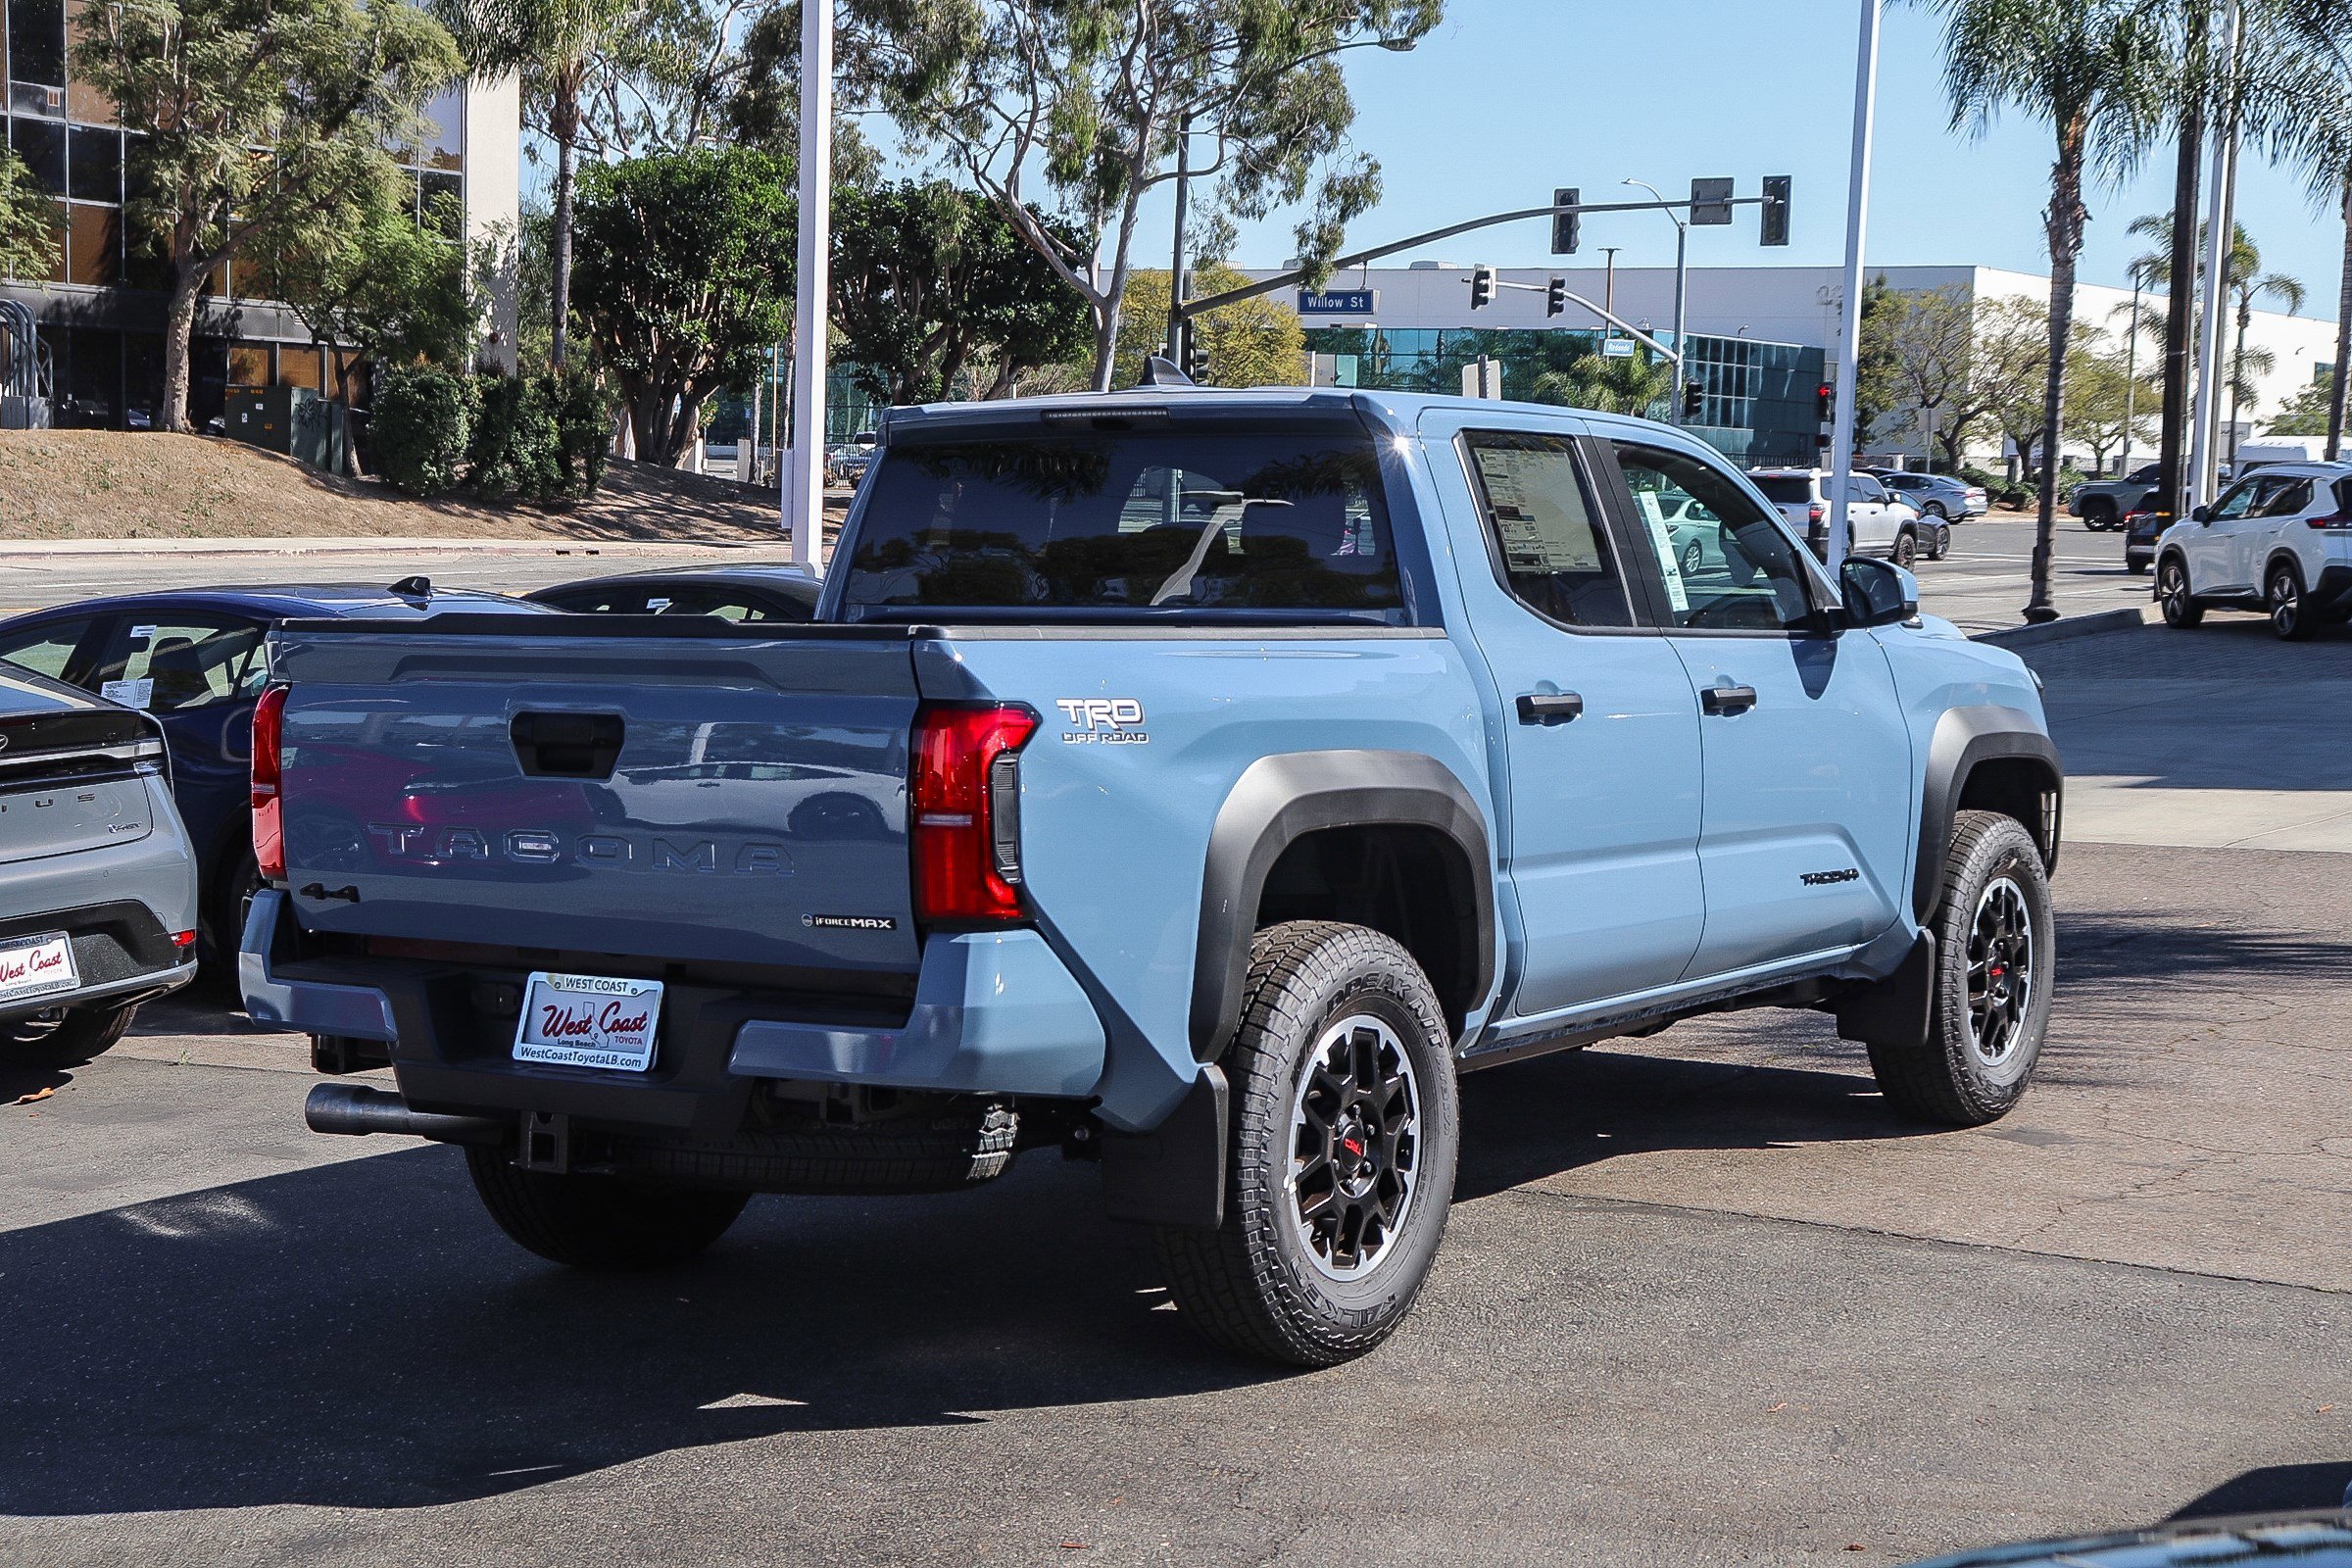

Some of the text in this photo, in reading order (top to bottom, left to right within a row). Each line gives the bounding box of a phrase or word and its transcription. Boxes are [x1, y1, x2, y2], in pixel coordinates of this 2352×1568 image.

[1307, 296, 1364, 308] Willow St
[1055, 699, 1143, 730] TRD
[1061, 732, 1149, 744] OFF ROAD
[368, 820, 796, 877] TACOMA
[29, 950, 62, 971] Coast
[564, 977, 629, 993] WEST COAST
[542, 1001, 648, 1037] West Coast
[557, 1039, 596, 1048] Long Beach
[614, 1035, 643, 1046] TOYOTA
[519, 1046, 642, 1068] WestCoastToyotaLB.com
